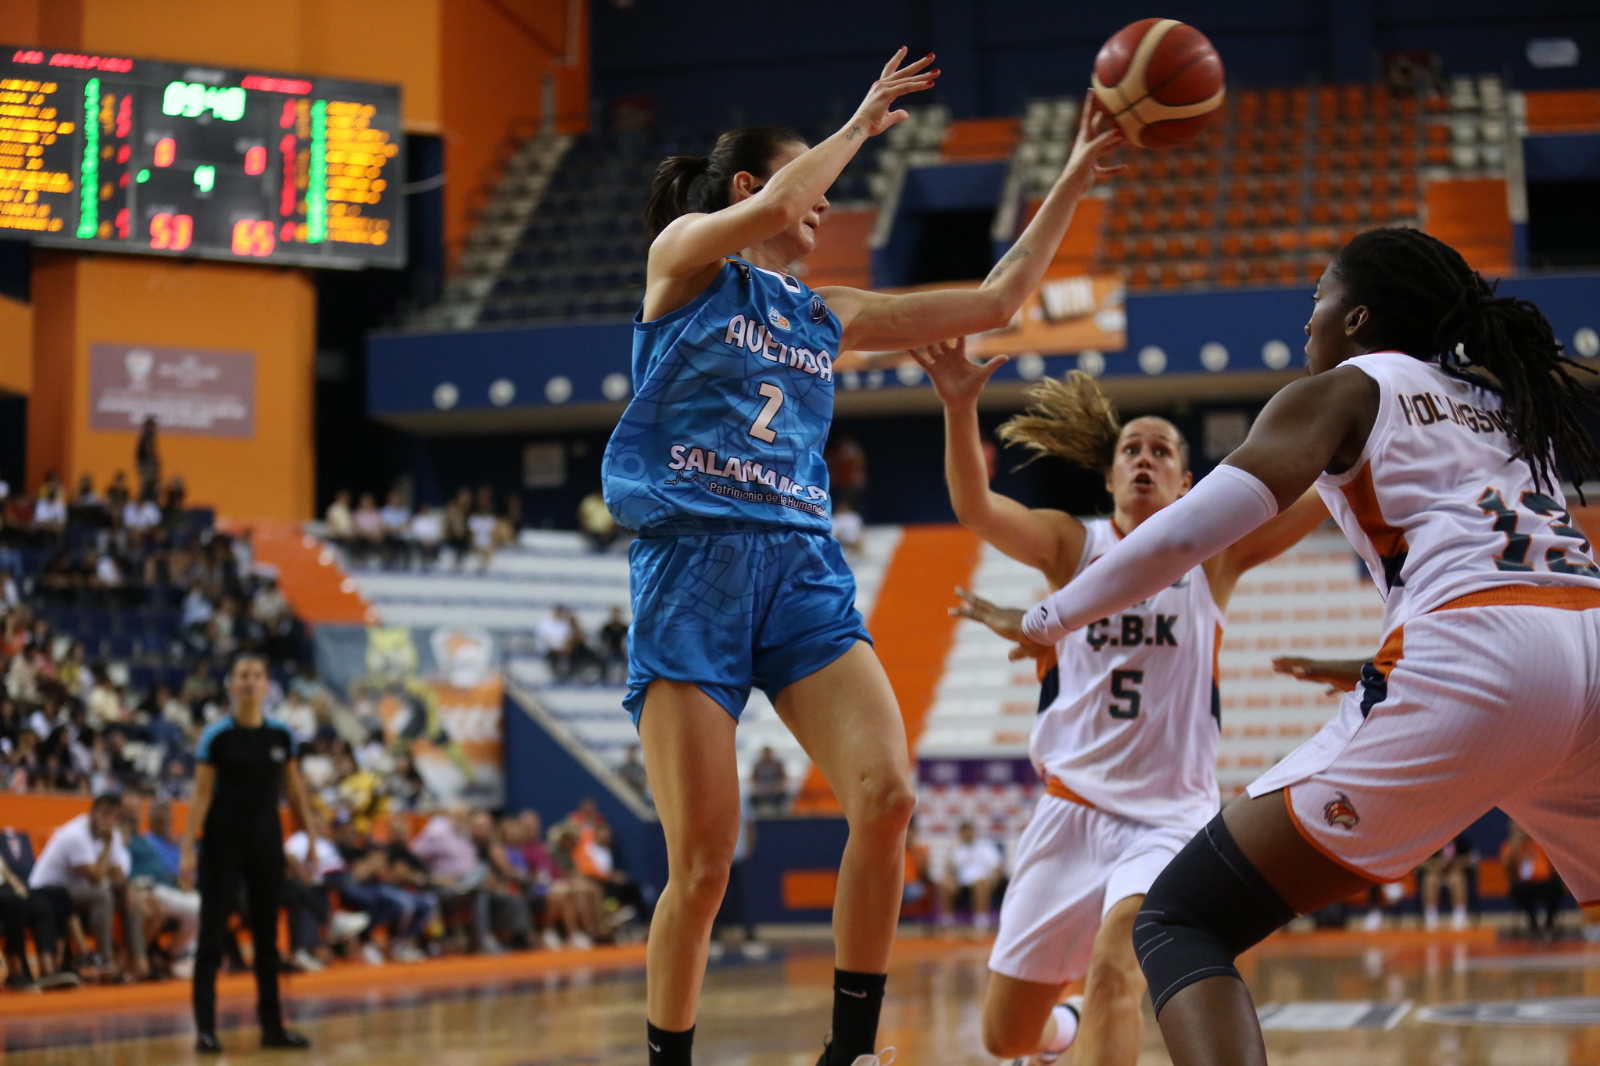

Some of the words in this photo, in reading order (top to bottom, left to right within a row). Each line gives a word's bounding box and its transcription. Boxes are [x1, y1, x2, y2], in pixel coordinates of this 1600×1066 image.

[749, 382, 784, 444] 2
[667, 444, 828, 502] SALAMANCA
[709, 482, 763, 502] Patrimonio
[766, 492, 778, 502] de
[780, 493, 788, 505] la
[1108, 669, 1144, 720] 5
